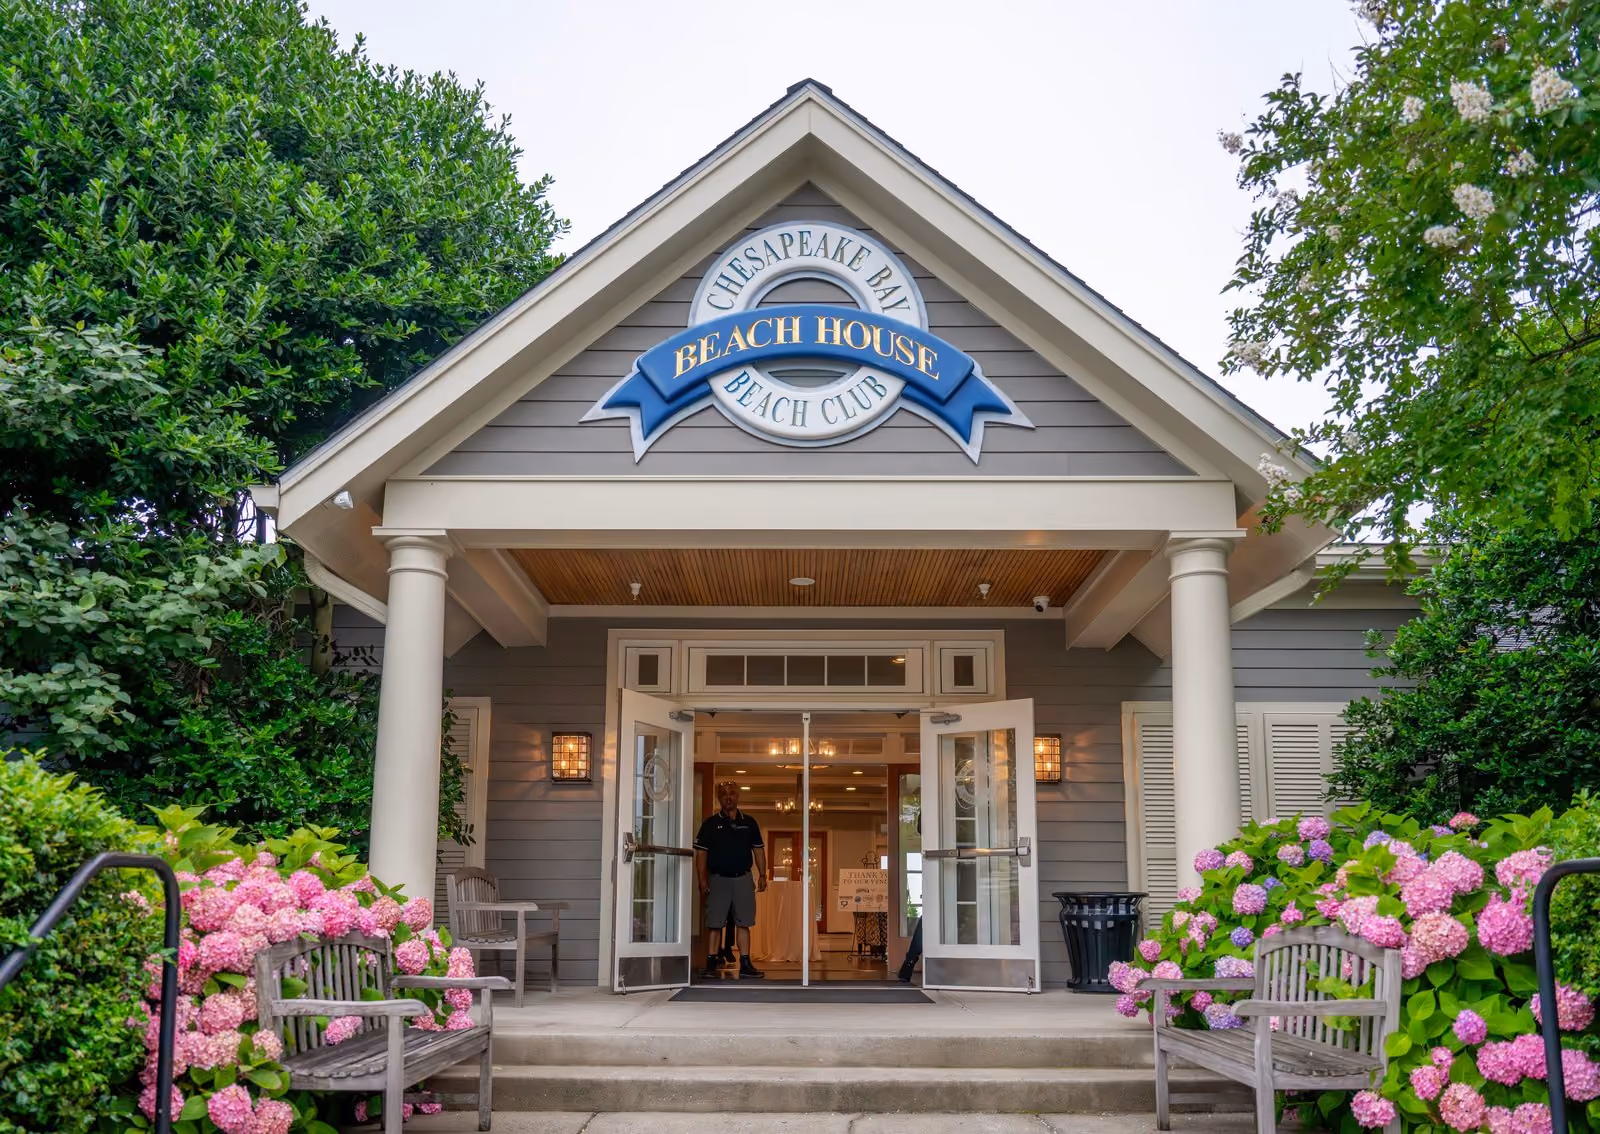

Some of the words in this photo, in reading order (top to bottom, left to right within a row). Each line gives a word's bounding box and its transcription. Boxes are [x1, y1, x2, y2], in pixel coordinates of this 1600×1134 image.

[706, 230, 872, 311] CHESAPEAKE
[865, 264, 910, 313] BAY
[673, 316, 803, 379] BEACH
[814, 315, 940, 380] HOUSE
[723, 370, 808, 428] BEACH
[821, 375, 888, 425] CLUB
